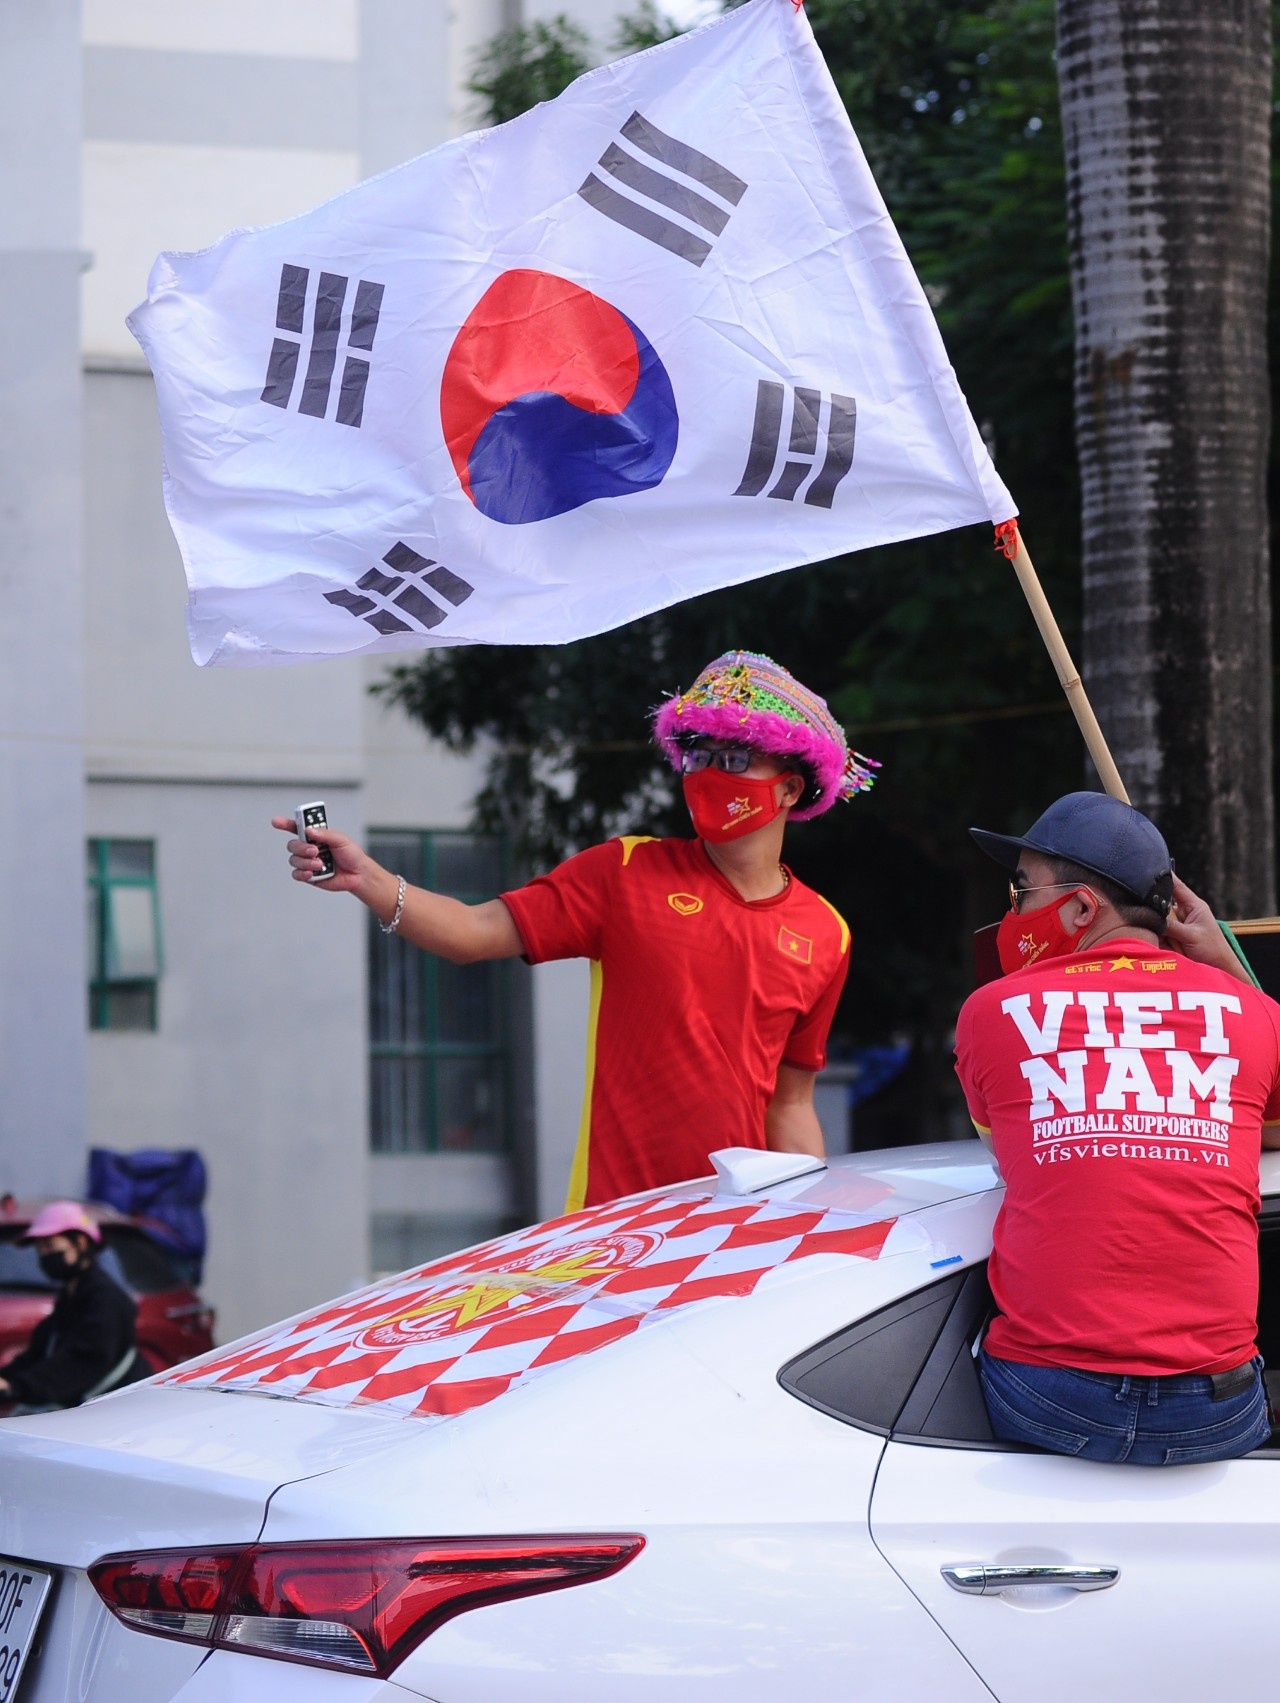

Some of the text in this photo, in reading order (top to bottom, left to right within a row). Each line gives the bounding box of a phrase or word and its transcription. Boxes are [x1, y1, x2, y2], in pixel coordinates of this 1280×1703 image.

[1001, 991, 1242, 1055] VIET
[1019, 1048, 1240, 1123] NAM
[1033, 1114, 1229, 1142] FOOTBALL SUPPORTERS
[1033, 1139, 1230, 1167] vfsvietnam.vn
